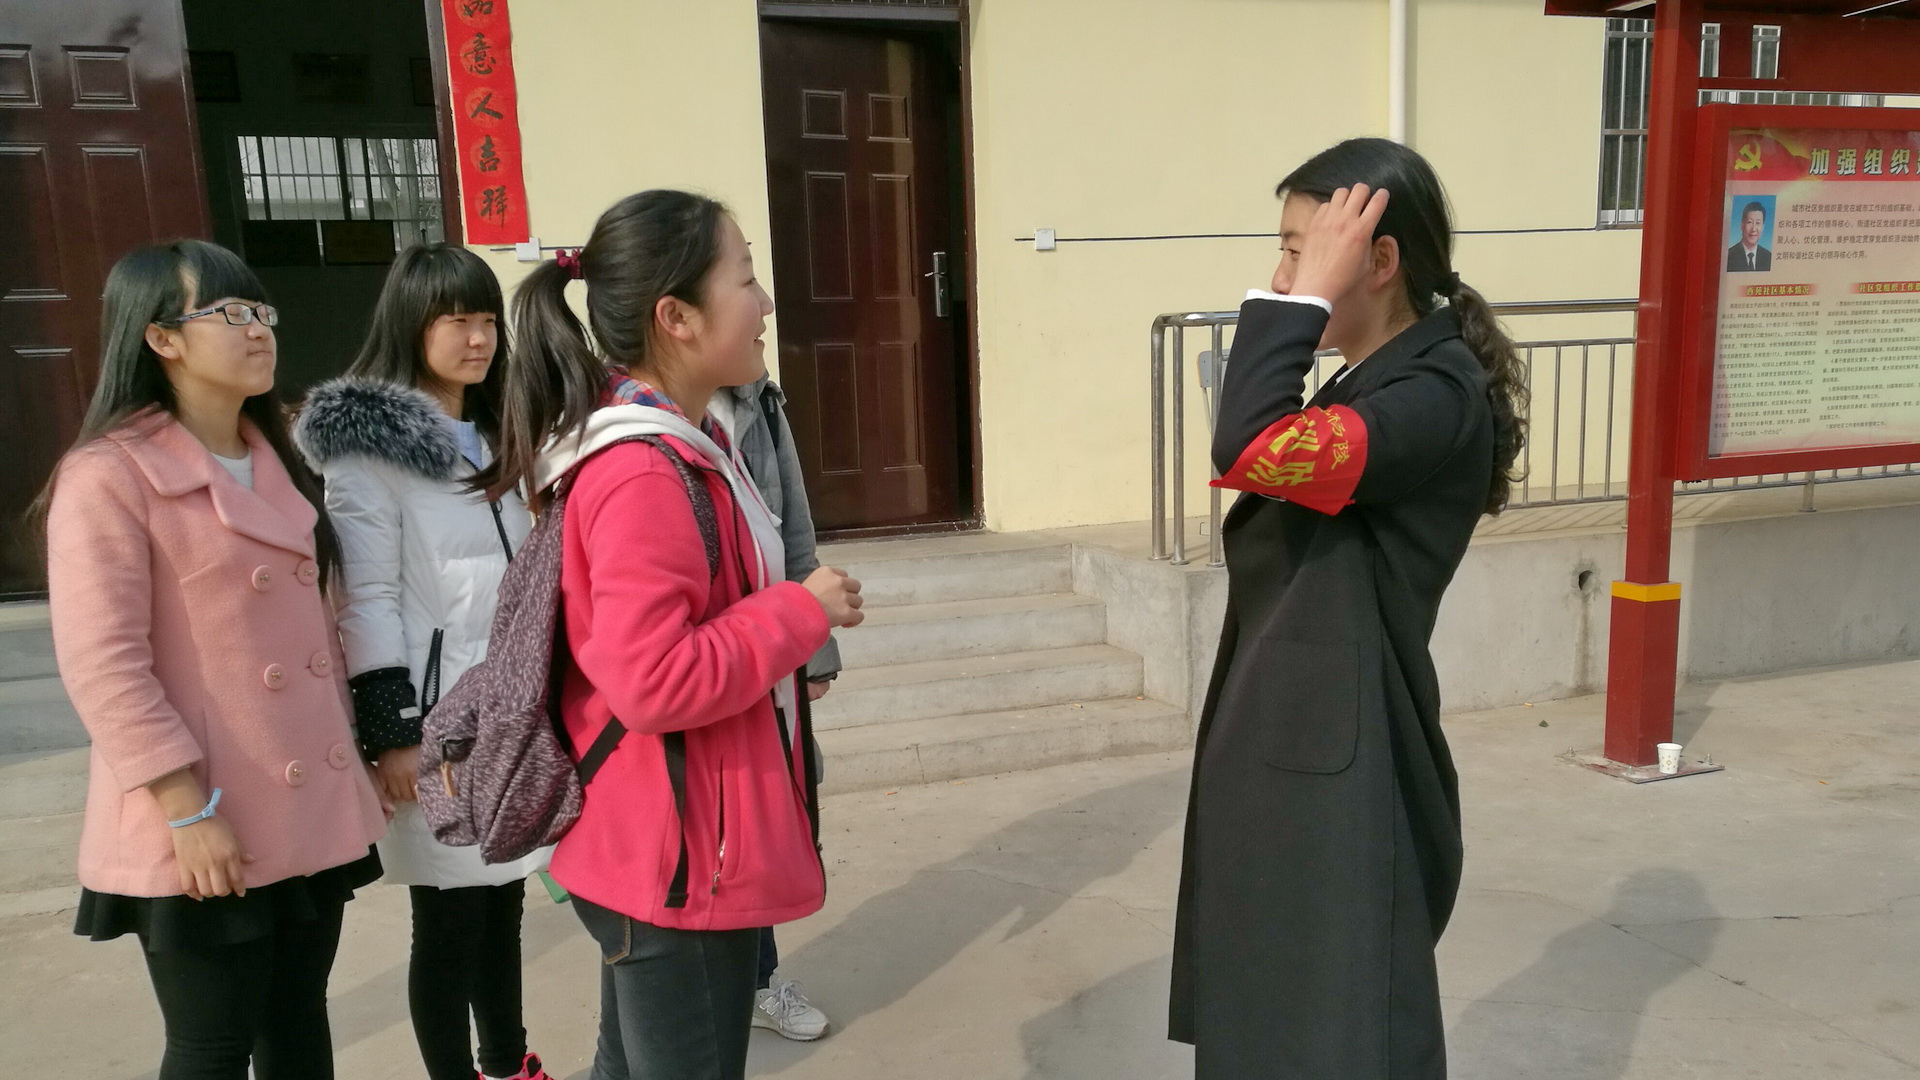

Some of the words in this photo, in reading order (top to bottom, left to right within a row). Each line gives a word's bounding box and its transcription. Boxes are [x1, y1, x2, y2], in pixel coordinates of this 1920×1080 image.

[1808, 147, 1920, 176] 加强组织
[1791, 203, 1920, 213] 城市社区党组织是党在城市工作的组织基础，
